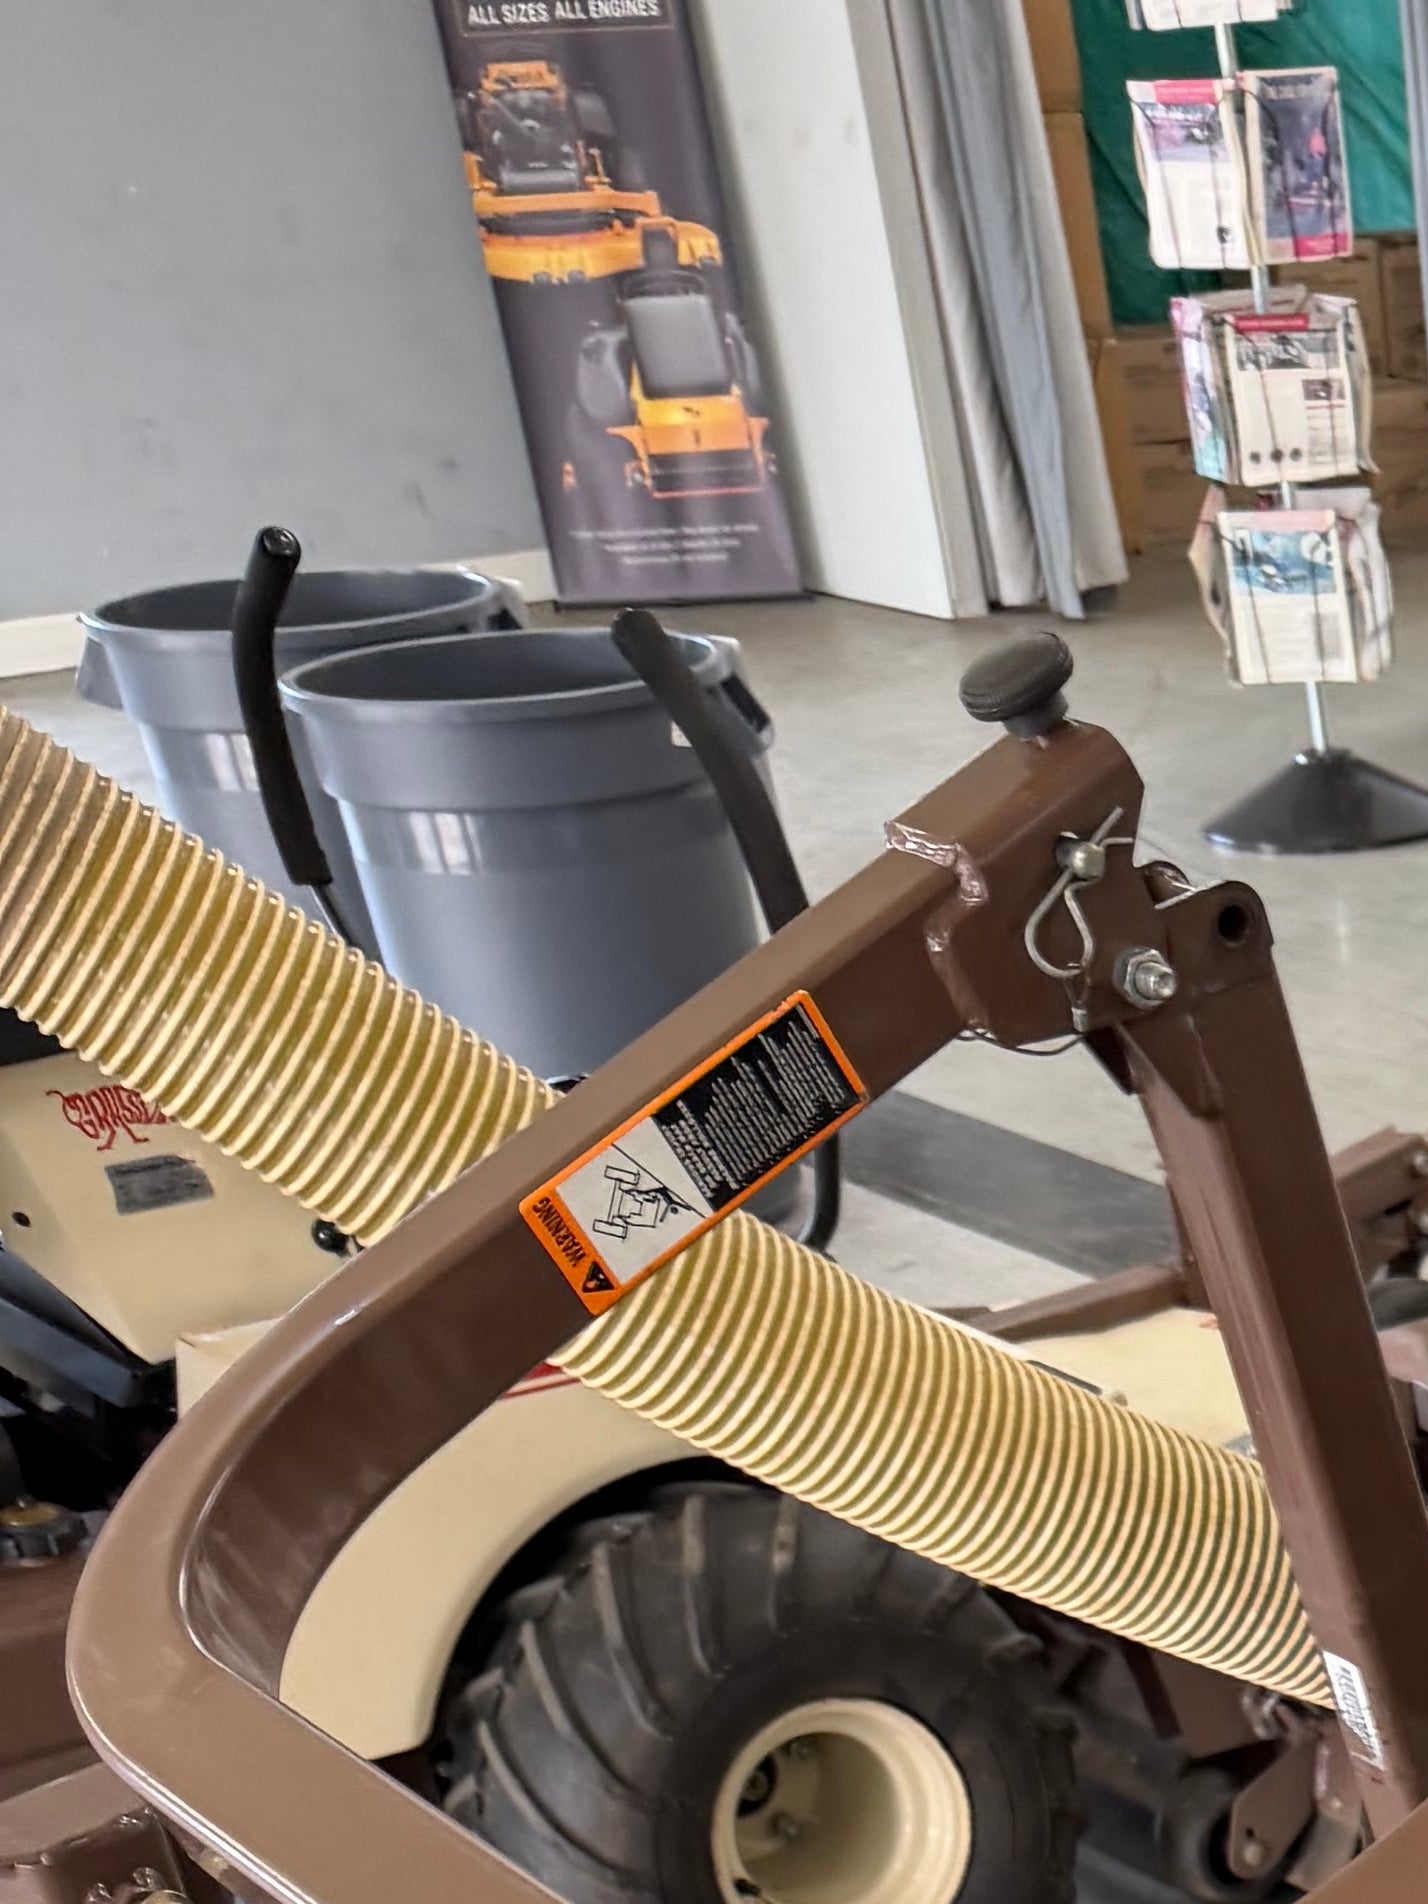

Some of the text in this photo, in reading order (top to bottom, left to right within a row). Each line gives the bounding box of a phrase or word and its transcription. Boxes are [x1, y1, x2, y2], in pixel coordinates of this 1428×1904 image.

[467, 0, 660, 25] ALL SIZES ALL ENGINES
[530, 1196, 587, 1268] WARNING
